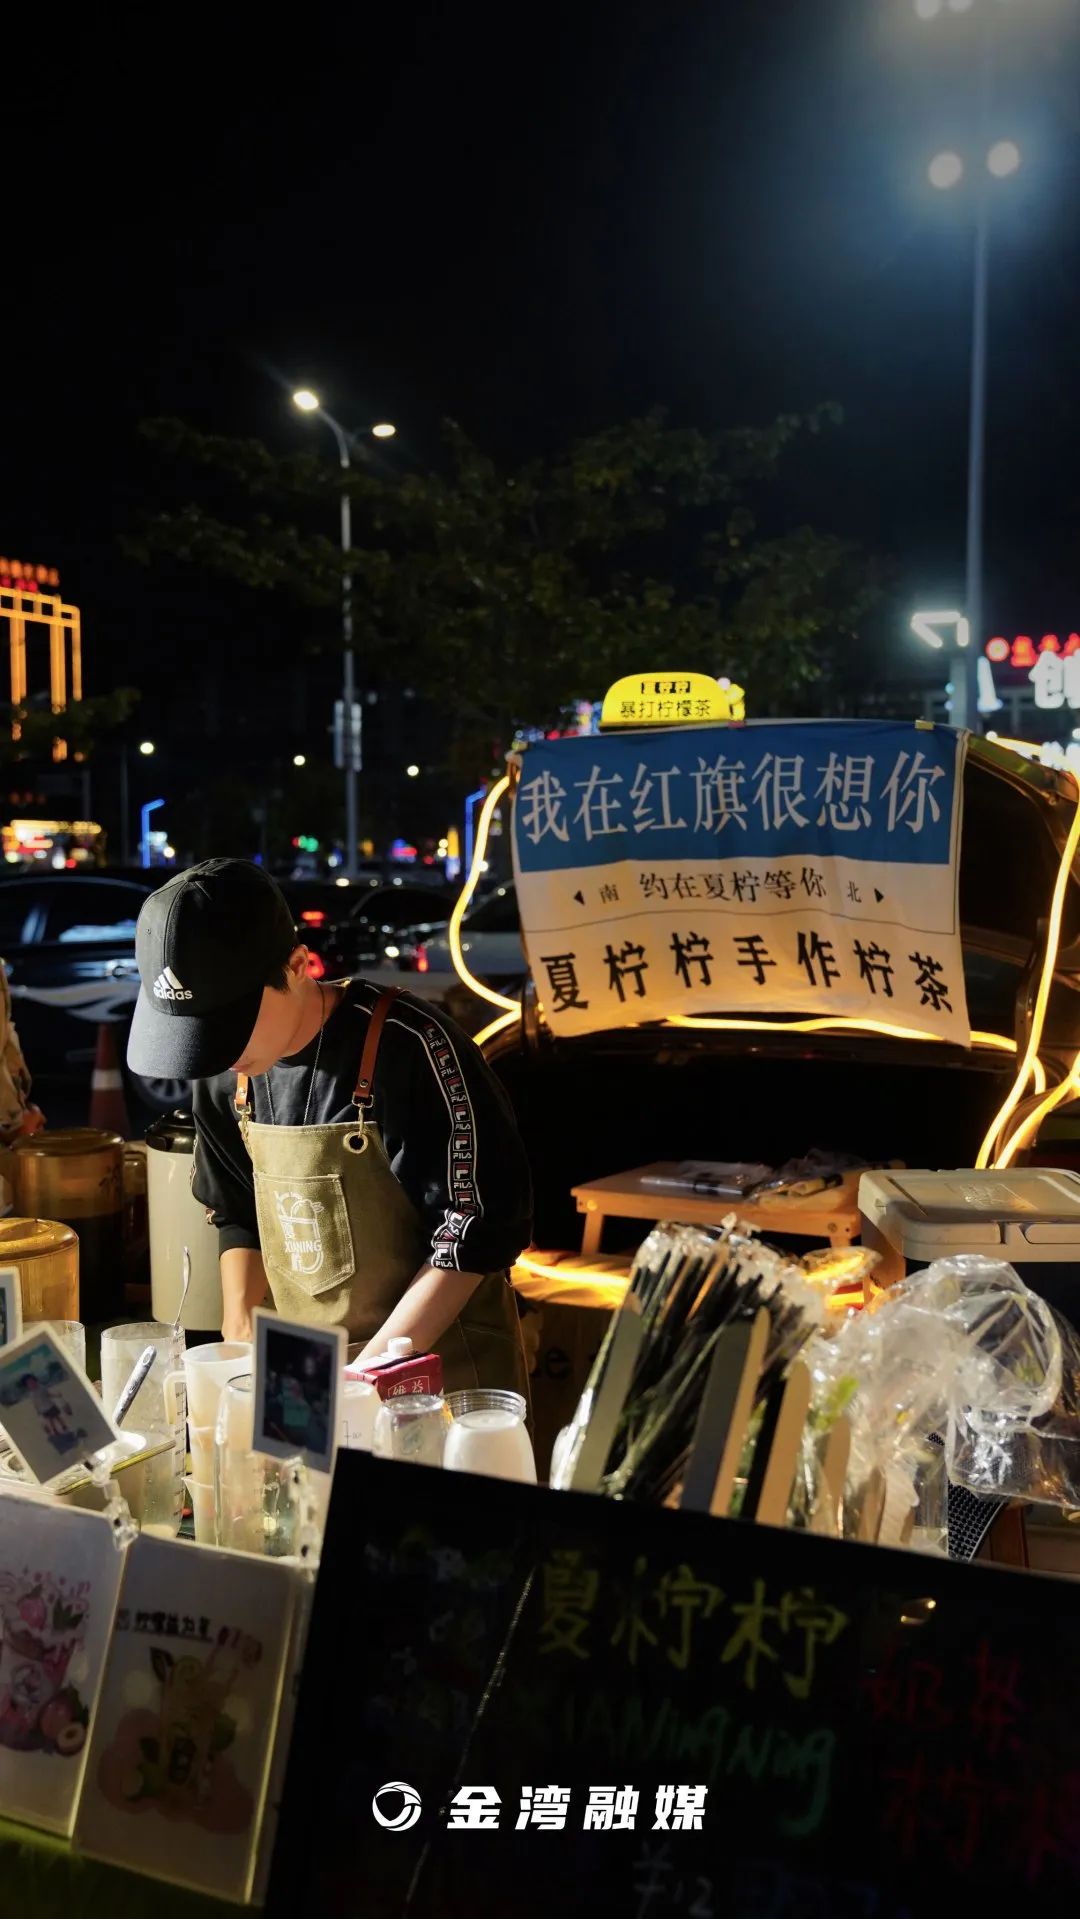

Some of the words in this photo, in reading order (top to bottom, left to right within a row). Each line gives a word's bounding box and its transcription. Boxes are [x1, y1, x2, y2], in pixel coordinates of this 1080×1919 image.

[620, 699, 711, 718] 暴打柠檬茶
[520, 750, 946, 845] 我在红旗很想你
[599, 887, 619, 904] 南
[639, 866, 828, 902] 约在夏柠等你
[847, 881, 862, 903] 北
[540, 931, 953, 1014] 夏柠柠手作柠茶
[153, 987, 193, 1000] adidas
[450, 1094, 468, 1103] FILA
[455, 1123, 472, 1131] FILA
[453, 1152, 472, 1160] FILA
[453, 1181, 473, 1189] FILA
[435, 1260, 454, 1268] FILA
[538, 1548, 850, 1700] 夏柠柠
